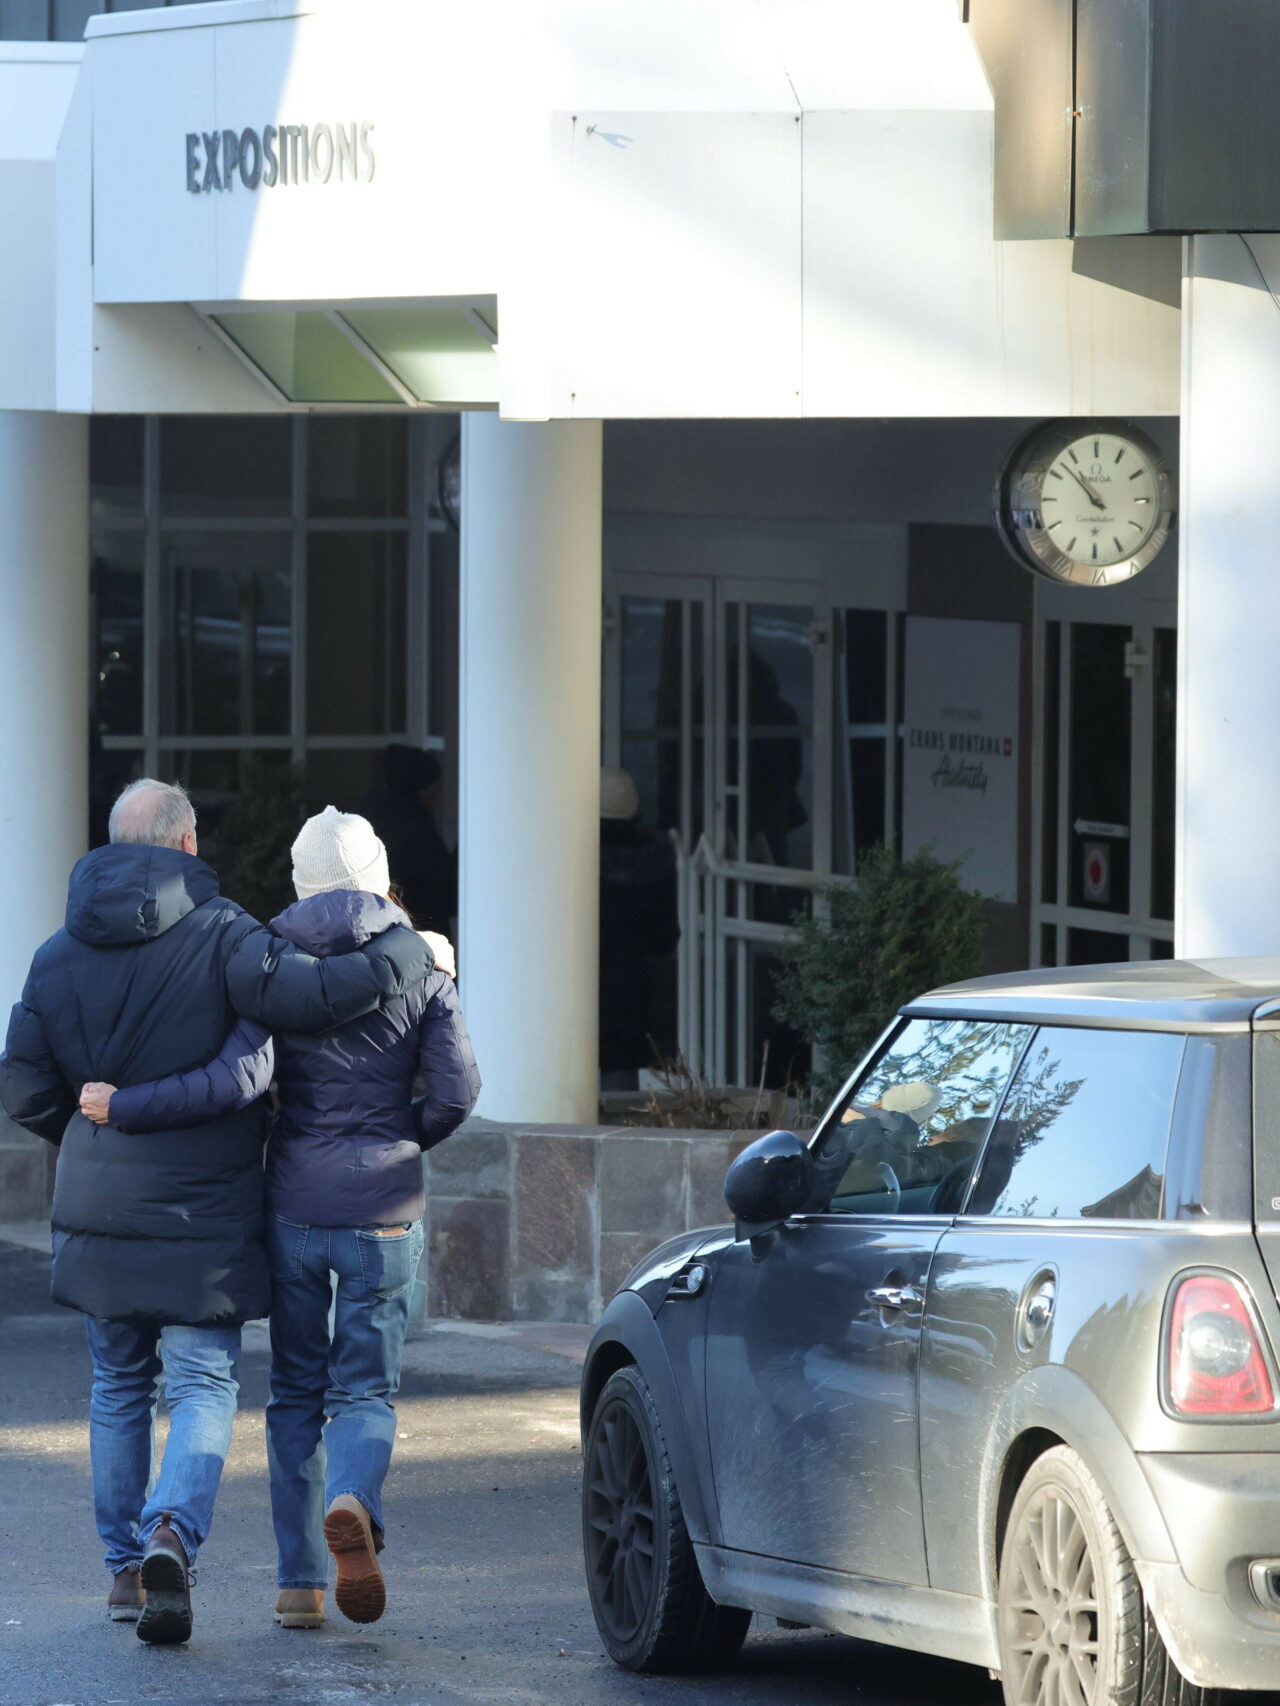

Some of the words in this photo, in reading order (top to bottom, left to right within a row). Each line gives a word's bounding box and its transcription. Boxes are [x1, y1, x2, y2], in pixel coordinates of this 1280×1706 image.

[185, 119, 376, 194] EXPOSITIONS
[1082, 474, 1111, 483] MEGA
[950, 732, 1001, 756] MONTANA
